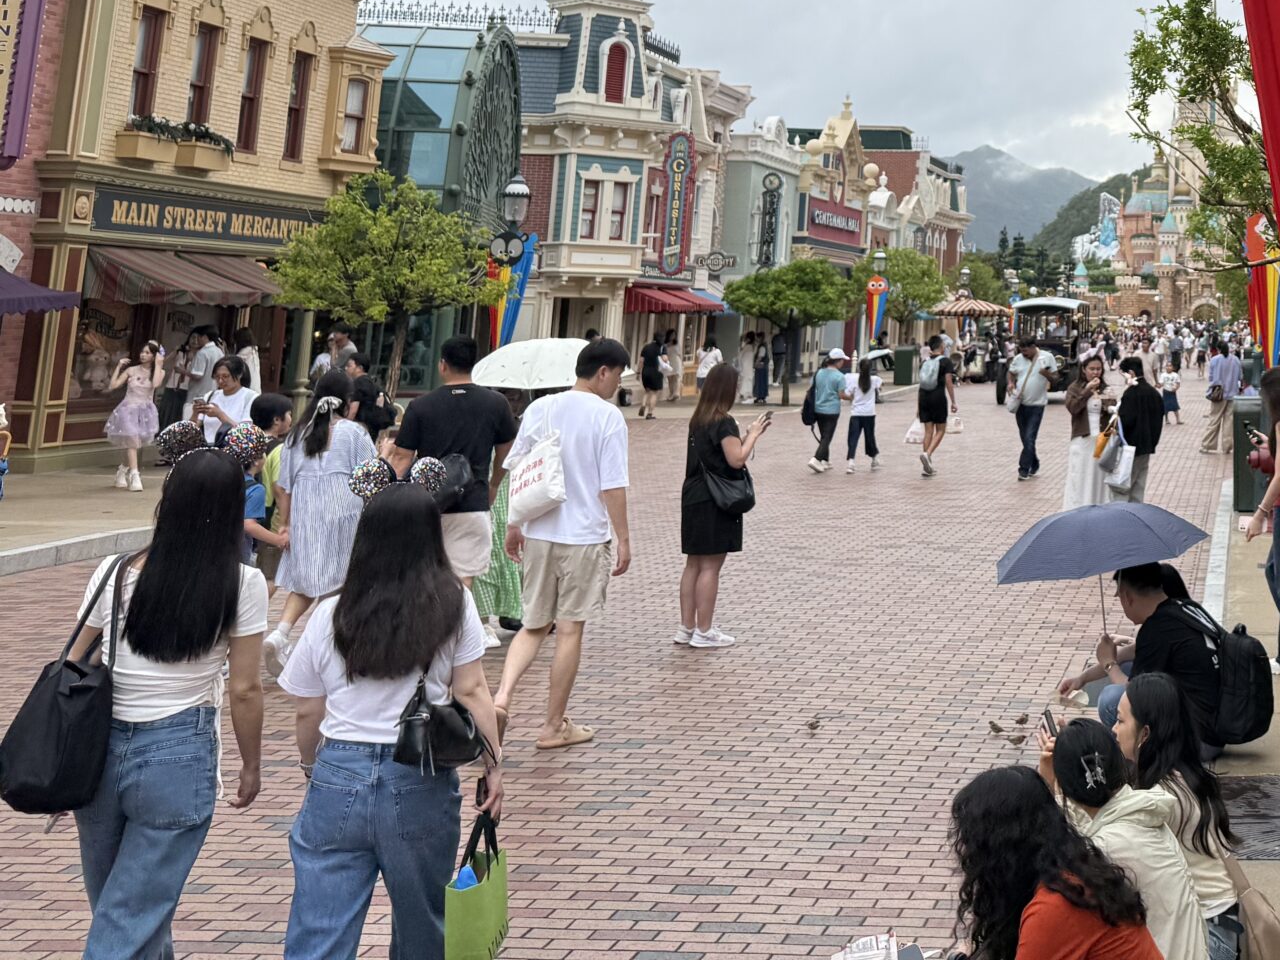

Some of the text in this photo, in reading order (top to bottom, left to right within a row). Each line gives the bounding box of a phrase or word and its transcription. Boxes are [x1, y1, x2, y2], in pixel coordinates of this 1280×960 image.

[111, 199, 159, 228] MAIN
[163, 205, 226, 233] STREET
[670, 159, 685, 245] CURIOSITY
